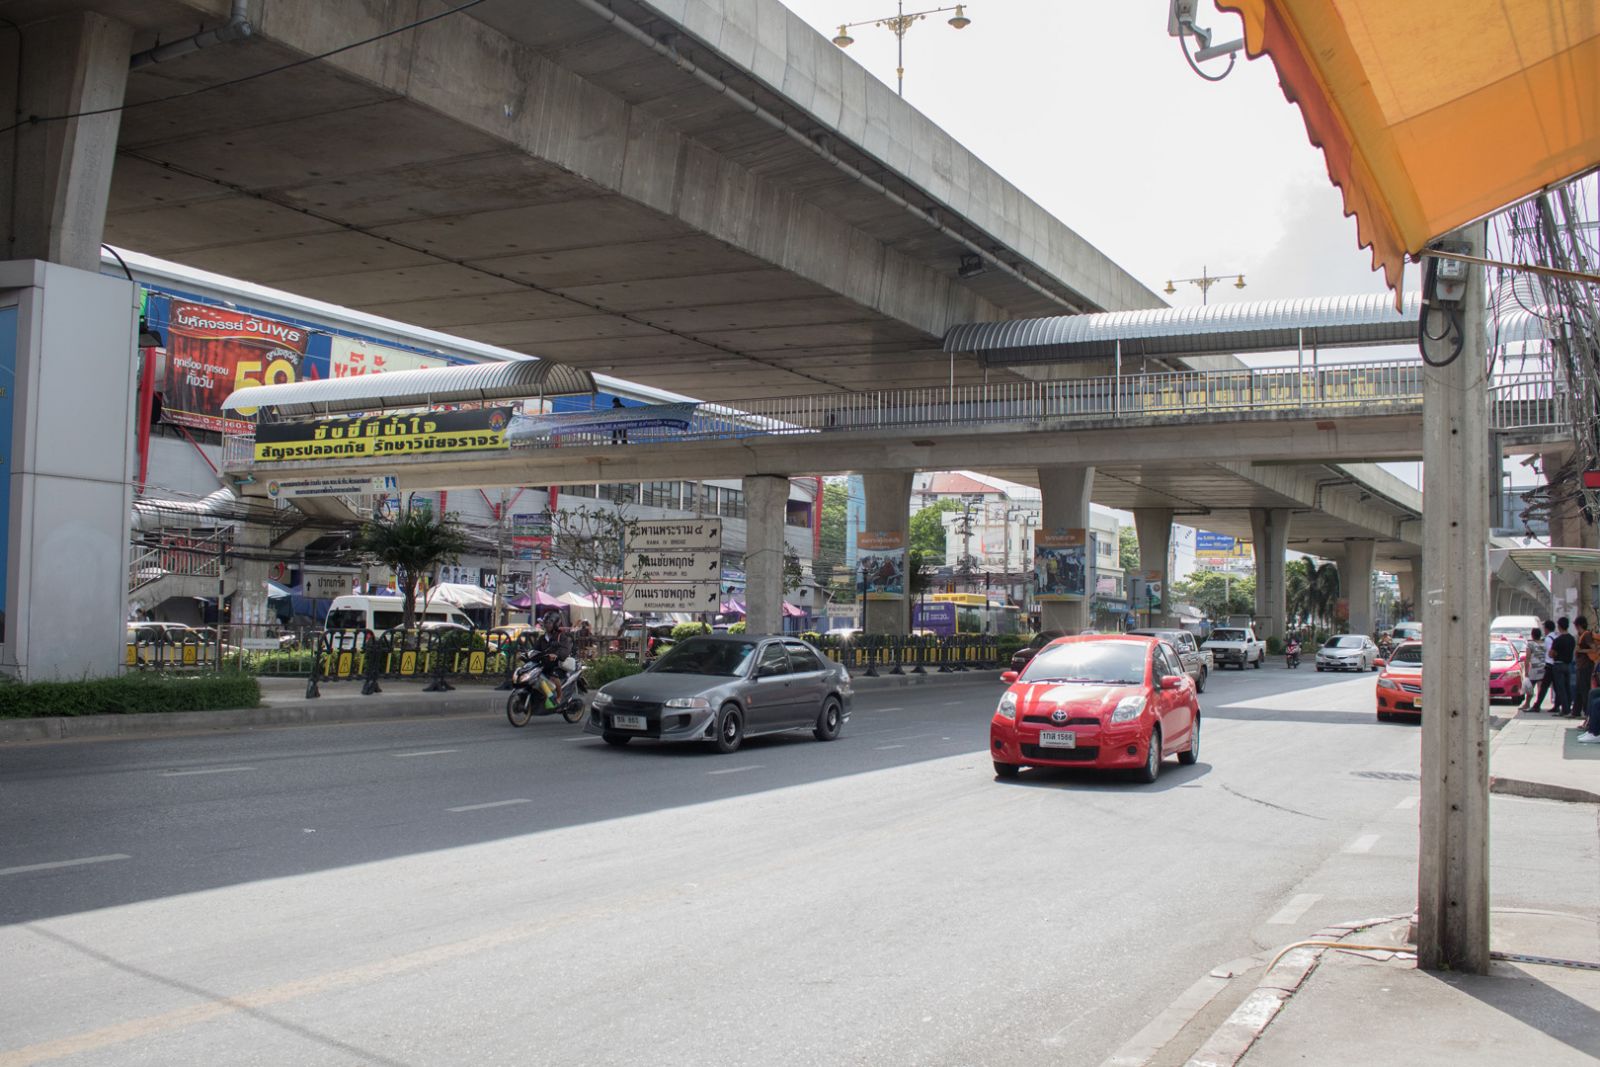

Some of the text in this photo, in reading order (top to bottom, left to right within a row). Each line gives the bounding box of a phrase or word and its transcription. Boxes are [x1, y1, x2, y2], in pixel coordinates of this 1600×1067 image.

[246, 318, 300, 342] วันพุธ
[635, 585, 696, 600] ถนนราชพฤกษ์
